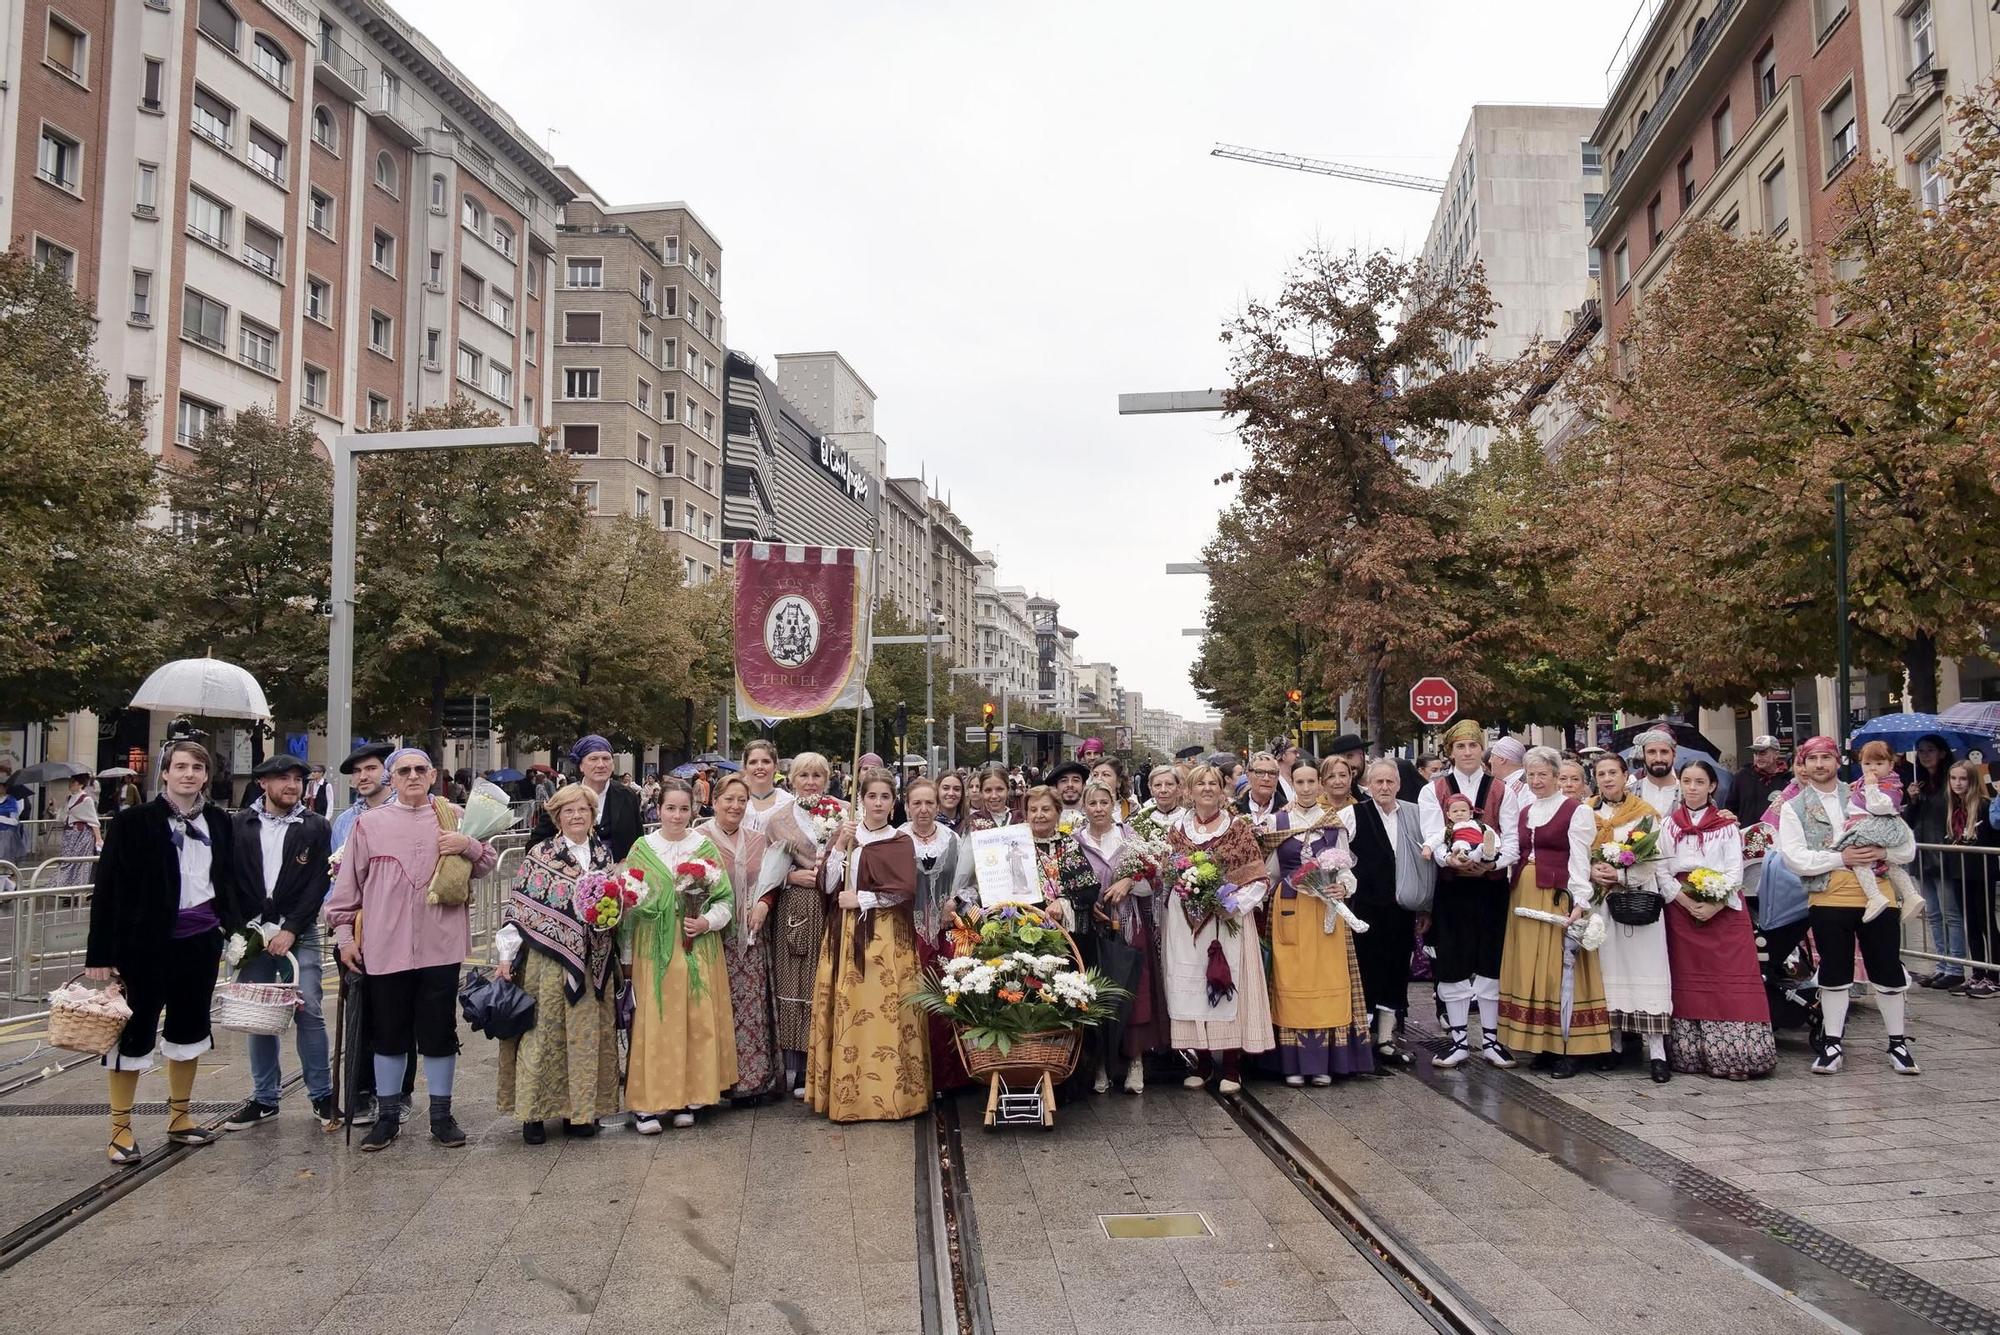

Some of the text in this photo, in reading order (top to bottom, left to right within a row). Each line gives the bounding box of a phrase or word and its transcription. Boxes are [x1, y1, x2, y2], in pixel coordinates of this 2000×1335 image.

[820, 436, 829, 467] El
[830, 445, 847, 480] Corte
[748, 587, 773, 628] TORRE
[776, 576, 804, 591] LOS
[759, 672, 820, 687] TERUEL
[1415, 695, 1453, 706] STOP
